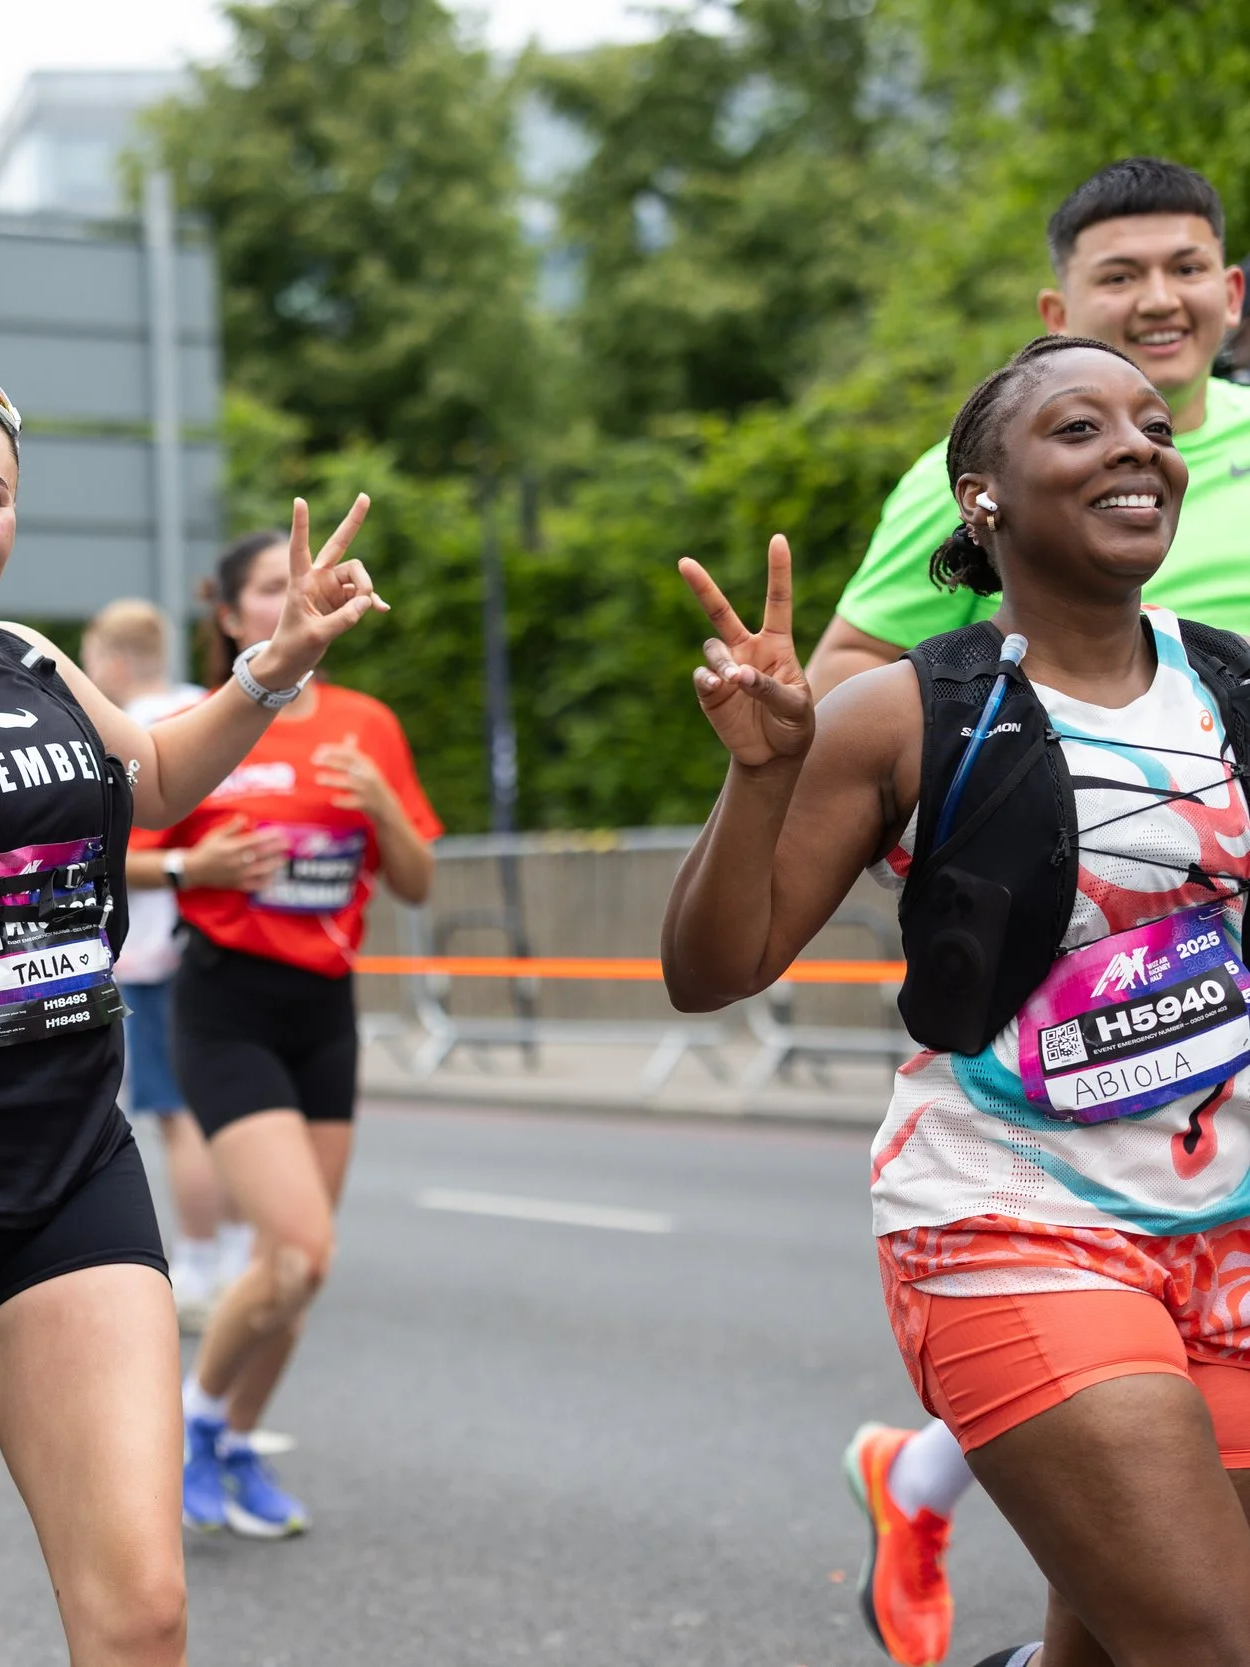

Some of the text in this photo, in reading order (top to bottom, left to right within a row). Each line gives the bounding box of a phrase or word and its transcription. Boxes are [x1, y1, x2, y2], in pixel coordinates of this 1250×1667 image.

[1176, 930, 1221, 960] 2025
[12, 953, 75, 985] TALIA
[44, 992, 88, 1011] H18493
[1095, 979, 1226, 1043] H5940
[46, 1011, 91, 1029] H18493
[1093, 1043, 1116, 1055] EVENT
[1117, 1033, 1158, 1049] EMERGENCY
[1158, 1023, 1184, 1036] NUMBER
[1076, 1051, 1192, 1106] ABIOLA
